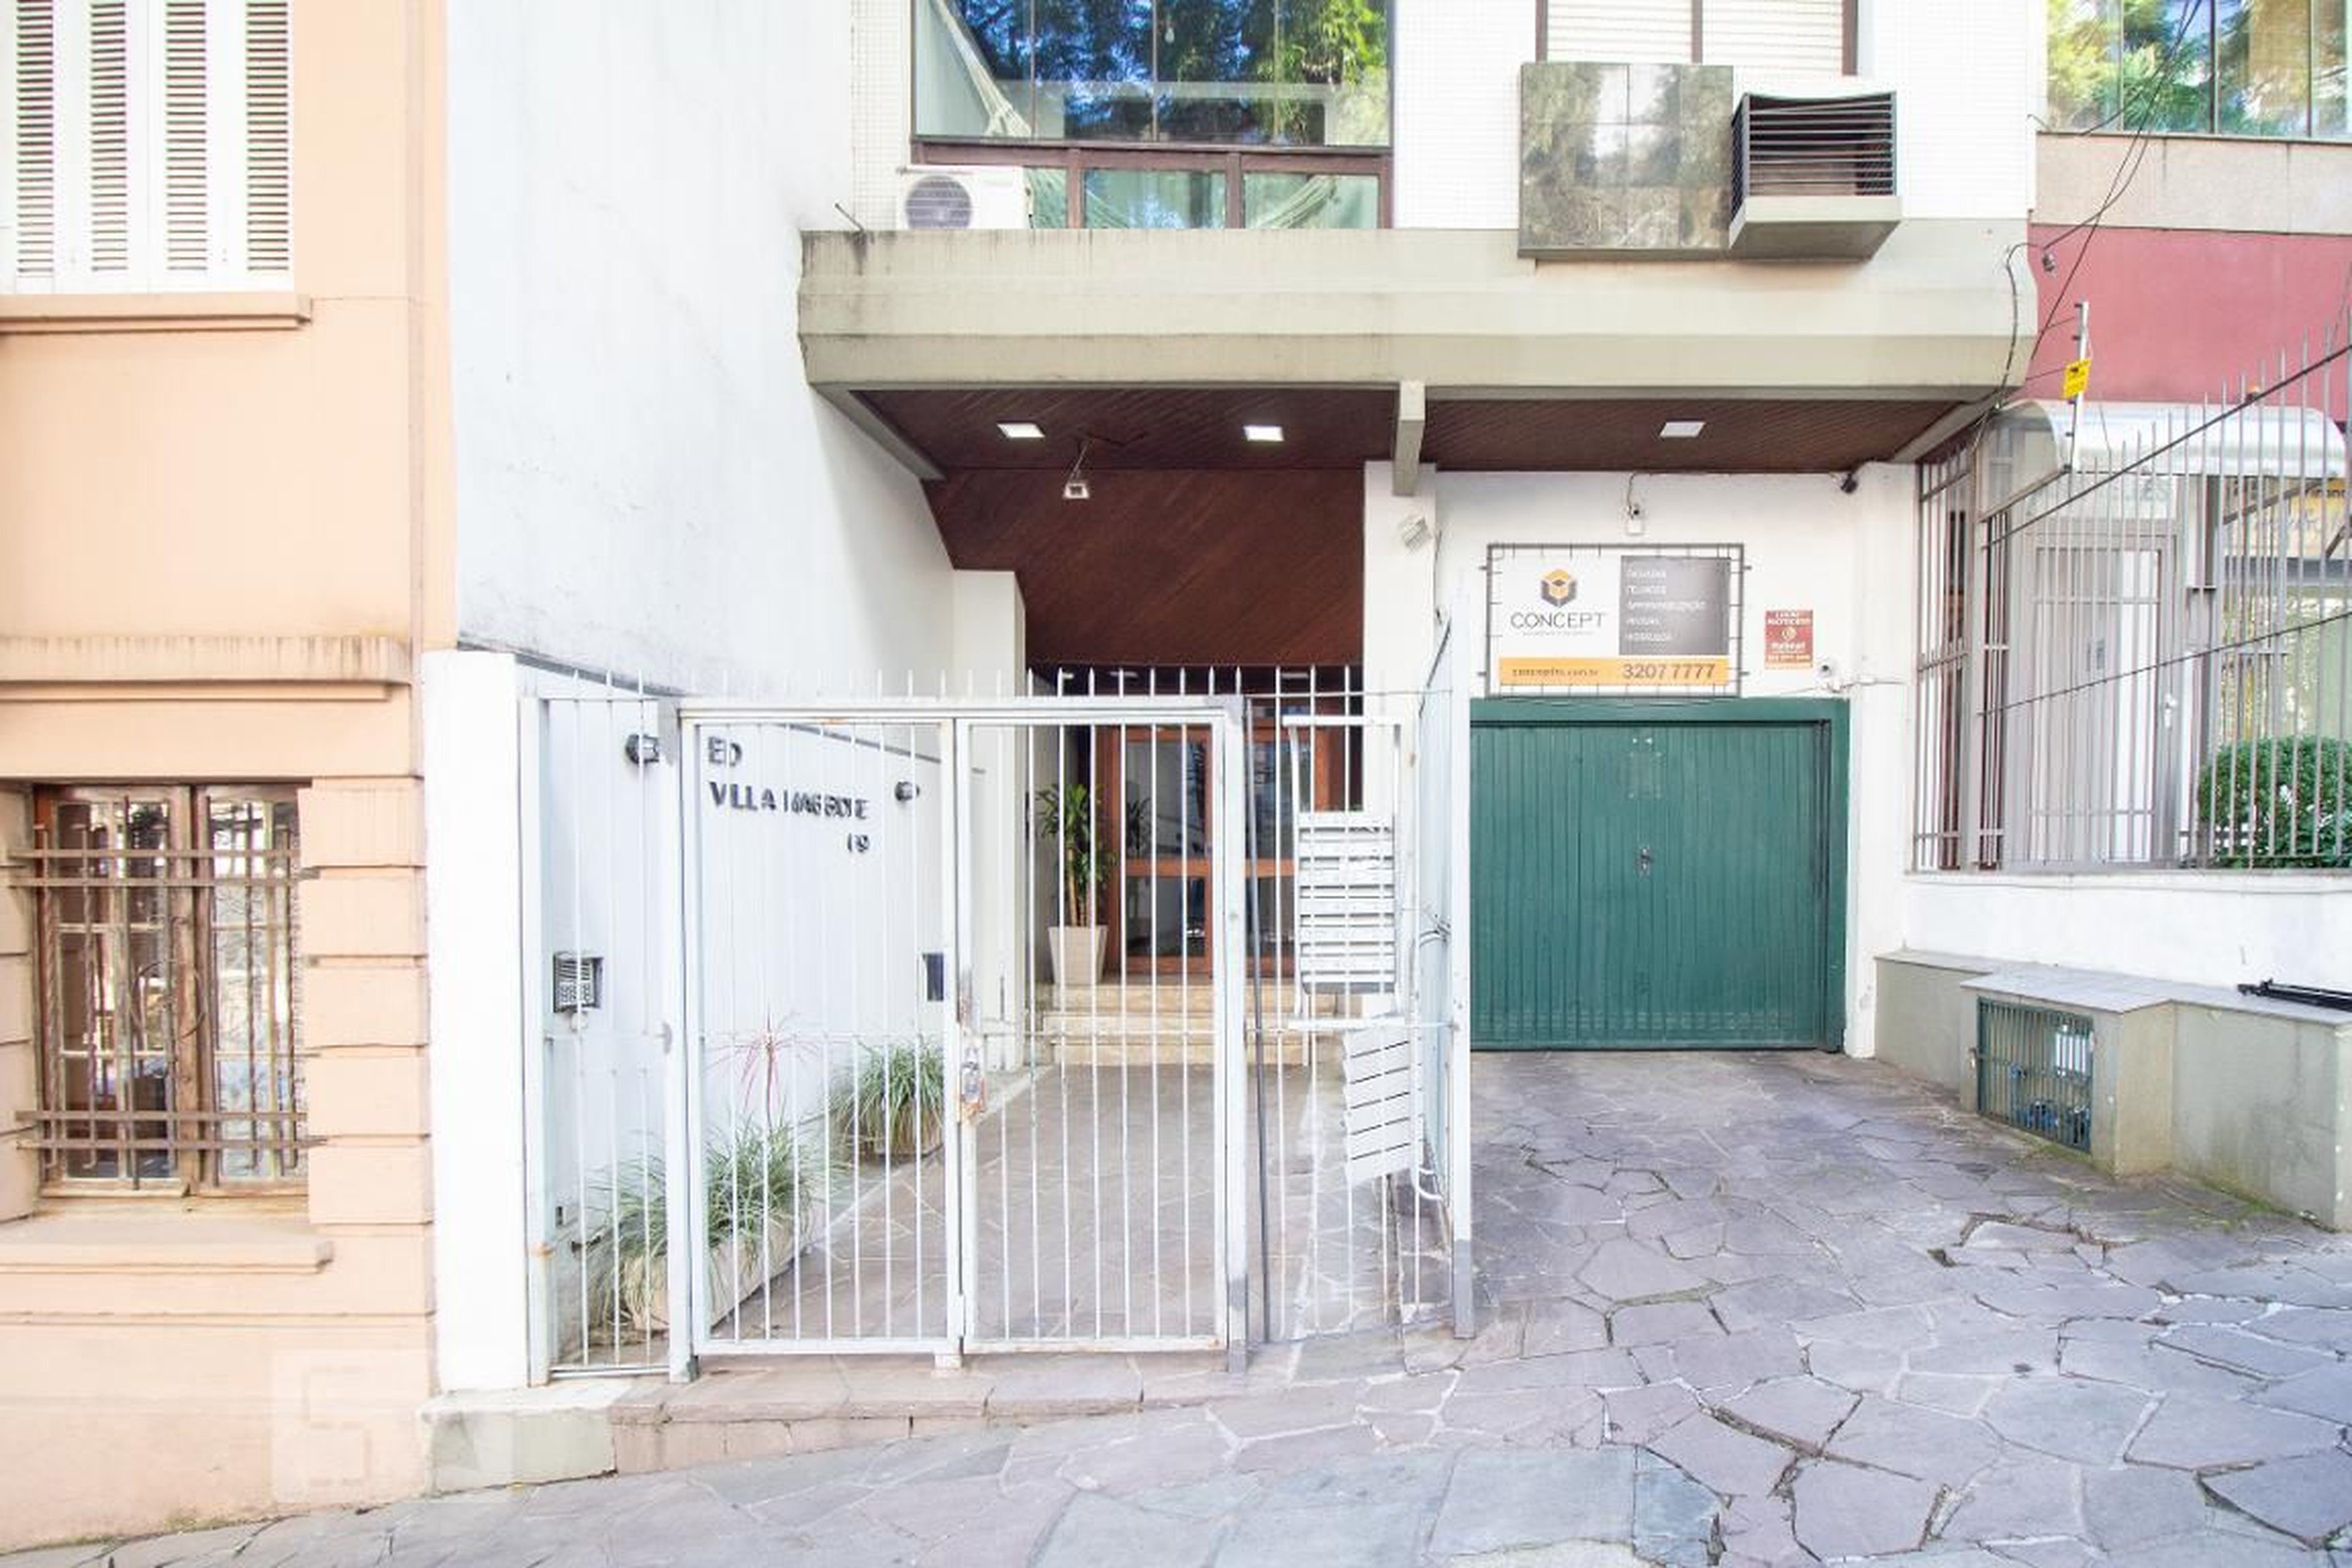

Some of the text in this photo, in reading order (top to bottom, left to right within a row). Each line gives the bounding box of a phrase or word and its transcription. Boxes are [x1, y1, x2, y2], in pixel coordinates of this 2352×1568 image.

[1510, 611, 1607, 629] CONCEPT
[1623, 663, 1716, 680] 3207 7777
[709, 781, 777, 812] VLLA
